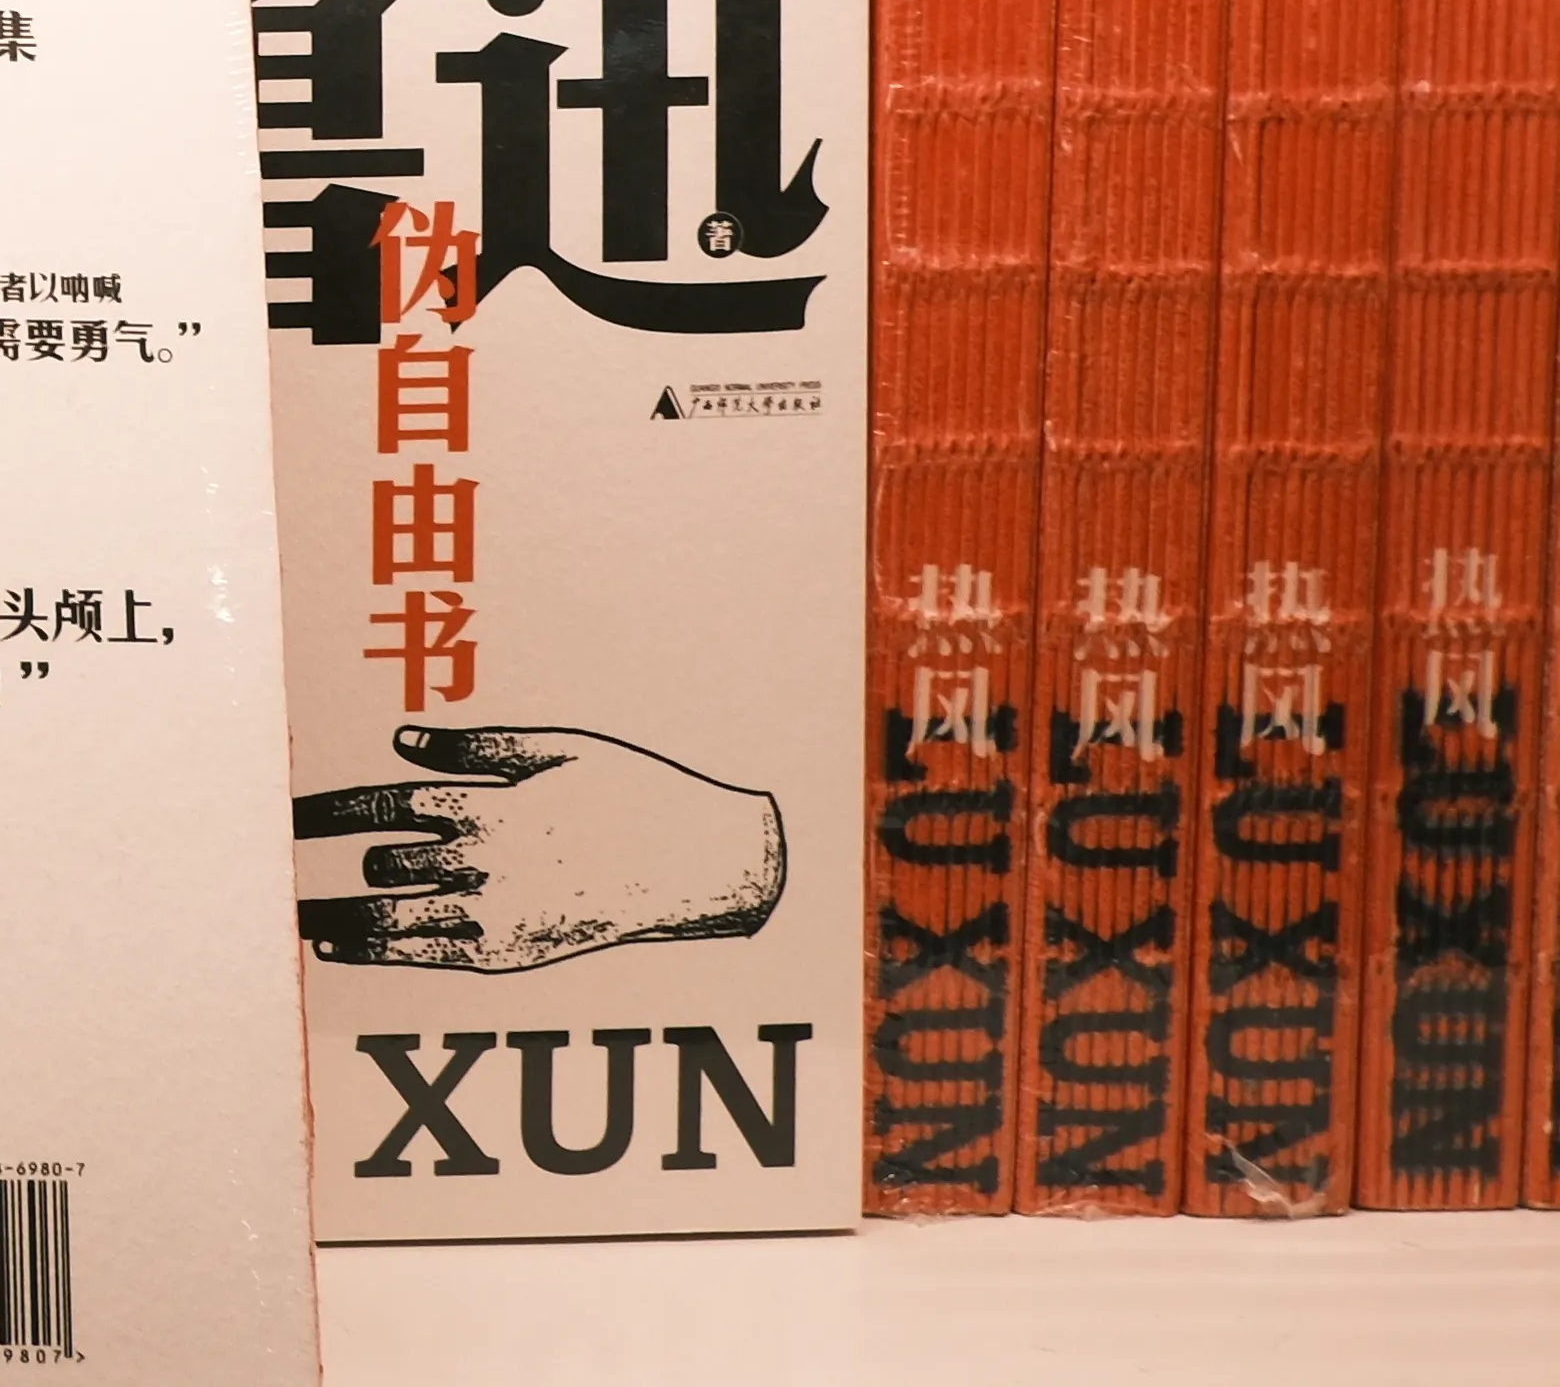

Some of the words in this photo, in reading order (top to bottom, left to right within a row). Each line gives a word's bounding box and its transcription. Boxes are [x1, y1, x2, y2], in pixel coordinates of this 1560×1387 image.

[362, 199, 481, 714] 伪自由书
[907, 561, 1004, 761] 热风
[1072, 564, 1171, 763] 热风
[1240, 557, 1335, 757] 热风
[352, 1022, 815, 1179] XUN
